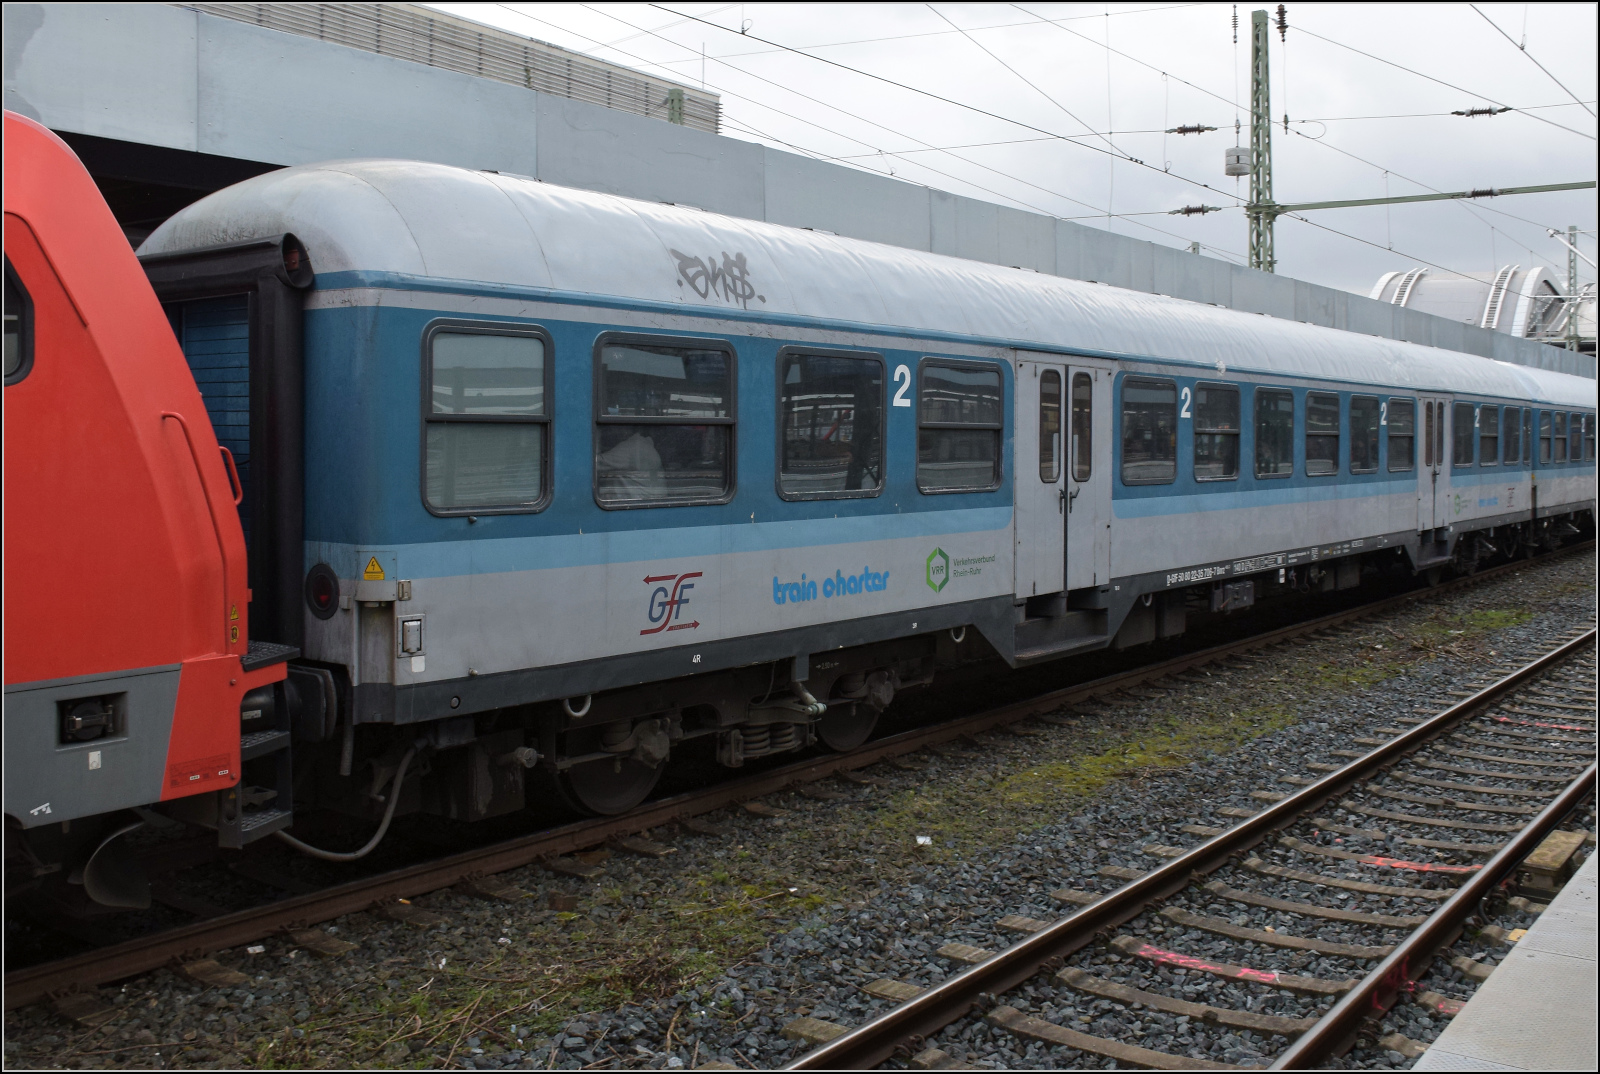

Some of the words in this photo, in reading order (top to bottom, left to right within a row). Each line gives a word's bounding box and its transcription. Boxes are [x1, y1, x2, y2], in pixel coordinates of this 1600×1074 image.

[893, 364, 911, 407] 2
[1180, 386, 1191, 418] 2
[1380, 402, 1387, 425] 2
[1475, 408, 1480, 427] 2
[953, 554, 996, 567] Verkehrsverbund
[931, 565, 945, 576] VRR
[953, 567, 982, 578] Rhein-Ruhr
[773, 576, 818, 605] train
[692, 654, 701, 663] 4R
